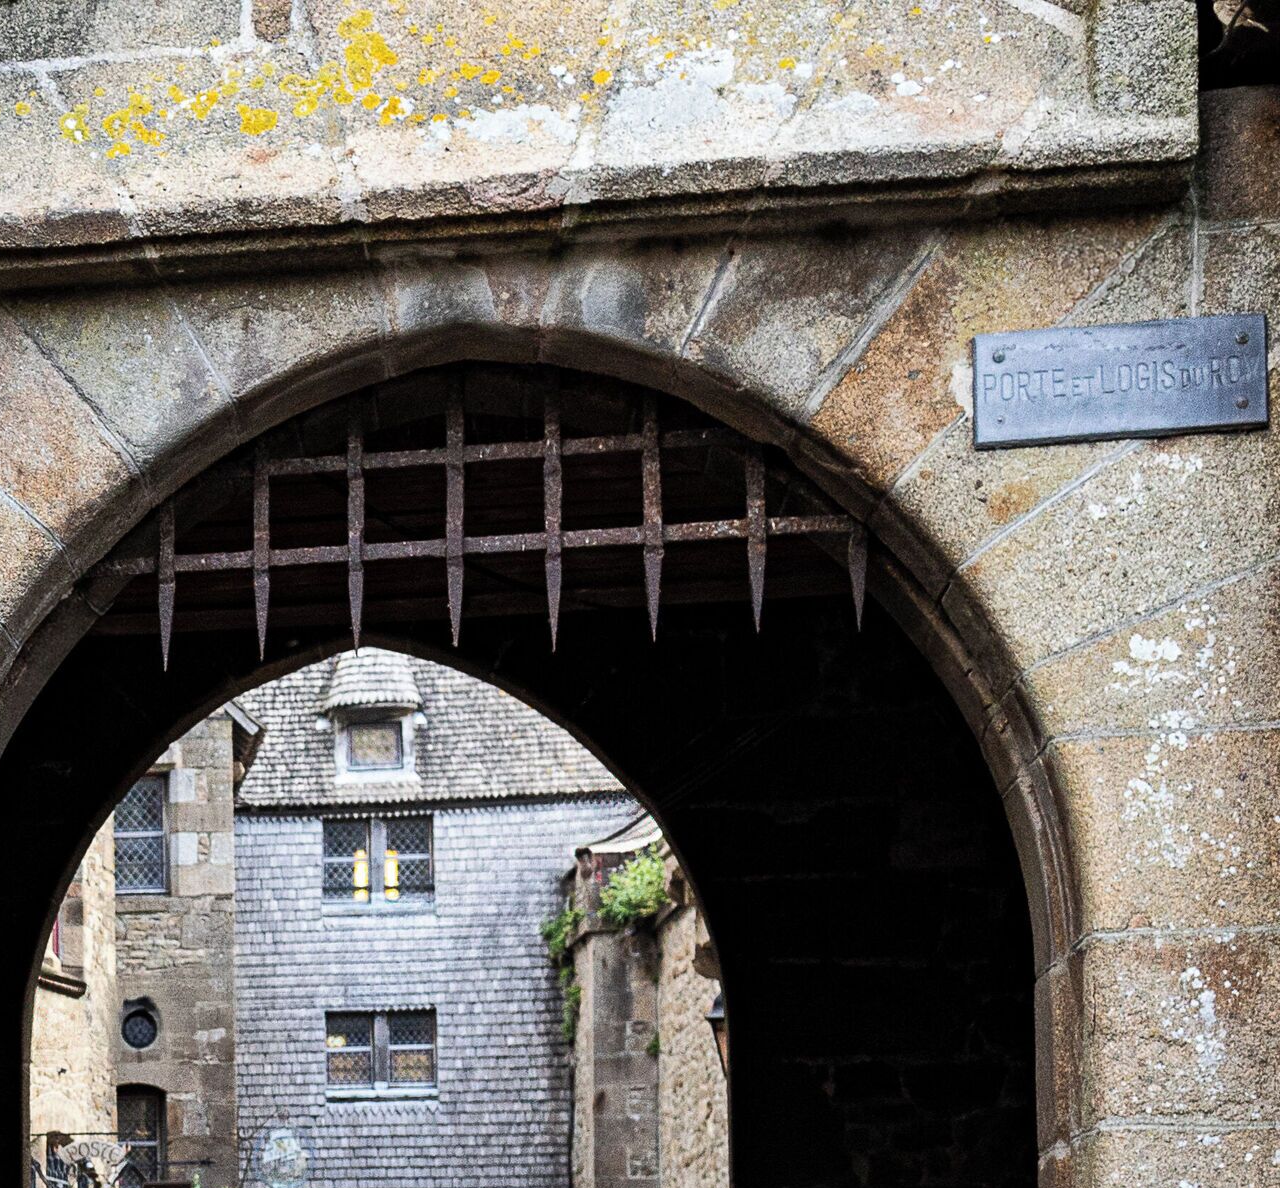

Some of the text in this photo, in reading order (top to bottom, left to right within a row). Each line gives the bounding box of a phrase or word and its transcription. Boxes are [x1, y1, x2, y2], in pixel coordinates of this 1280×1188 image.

[983, 368, 1065, 402] PORTE
[1072, 375, 1095, 397] ET
[1099, 359, 1175, 394] LOGIS
[1179, 367, 1204, 388] DU
